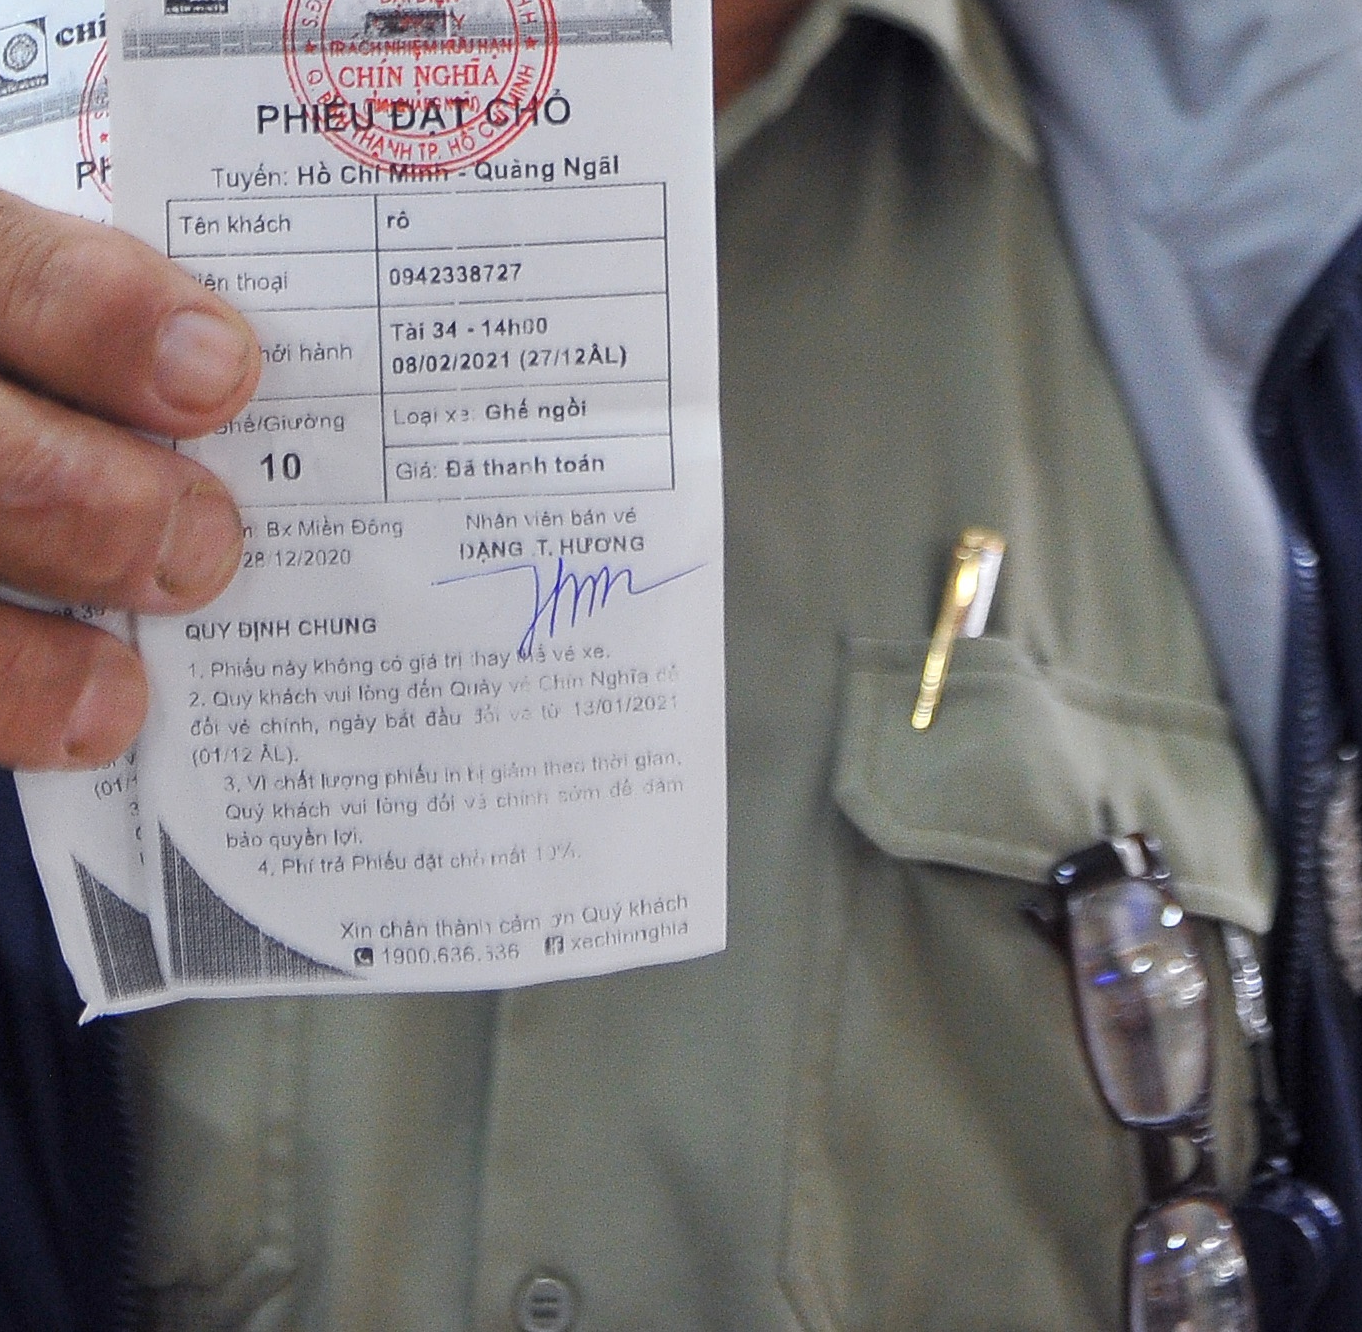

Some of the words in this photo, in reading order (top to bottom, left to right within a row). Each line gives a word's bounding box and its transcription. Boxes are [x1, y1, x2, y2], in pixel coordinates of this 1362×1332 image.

[338, 58, 403, 87] CHÍN
[414, 58, 500, 87] NGHĨA
[256, 93, 374, 134] PHIẾU
[212, 162, 287, 192] Tuyến:
[298, 161, 331, 185] Hồ
[341, 165, 380, 184] Chí
[389, 162, 450, 182] Minh
[475, 159, 554, 181] Quảng
[564, 155, 619, 179] Ngãi
[179, 215, 219, 234] Tên
[228, 214, 291, 233] khách
[387, 210, 410, 229] rô
[192, 272, 229, 291] iện
[237, 271, 288, 293] thoại
[389, 263, 522, 286] 0942338727
[390, 320, 424, 341] Tài
[433, 321, 456, 339] 34
[482, 317, 547, 336] 14h00
[300, 342, 353, 362] hành
[392, 351, 510, 374] 08/02/2021
[520, 343, 627, 371] (27/12ÂL)
[394, 409, 438, 427] Loại
[486, 398, 528, 420] Ghế
[538, 397, 586, 422] ngồi
[260, 453, 301, 481] 10
[395, 461, 438, 480] Giá:
[446, 460, 475, 478] Đã
[484, 457, 546, 476] thanh
[556, 454, 605, 472] toán
[267, 522, 291, 538] Bx
[298, 515, 344, 536] Miền
[351, 519, 403, 539] Đông
[466, 513, 517, 530] Nhân
[524, 511, 563, 527] viên
[571, 510, 606, 526] bán
[613, 507, 637, 523] vé
[560, 536, 645, 555] HƯƠNG
[185, 621, 231, 641] QUY
[238, 620, 290, 642] ĐỊNH
[298, 618, 377, 635] CHUNG
[189, 663, 203, 678] 1.
[211, 657, 265, 678] Phiếu
[272, 661, 307, 679] này
[313, 658, 372, 675] không
[380, 656, 403, 672] có
[409, 654, 437, 674] giá
[445, 651, 462, 671] trị
[471, 651, 510, 669] thay
[553, 646, 575, 661] vé
[582, 645, 610, 659] xe.
[189, 692, 205, 707] 2.
[259, 688, 317, 705] khách
[324, 686, 351, 702] vui
[359, 685, 399, 704] lòng
[407, 678, 442, 699] đến
[450, 679, 502, 698] Quầy
[591, 669, 648, 690] Nghĩa
[190, 716, 218, 736] đổi
[228, 717, 250, 734] vé
[260, 717, 319, 735] chính,
[329, 713, 376, 733] ngày
[385, 708, 415, 729] bắt
[425, 706, 461, 727] đầu
[192, 746, 253, 768] (01/12
[260, 744, 298, 765] ÂL).
[247, 774, 266, 791] Vì
[274, 769, 314, 791] chất
[321, 773, 378, 791] lượng
[385, 764, 437, 789] phiếu
[445, 768, 461, 783] in
[491, 762, 536, 783] giảm
[592, 753, 628, 771] thời
[225, 804, 264, 822] Quý
[272, 801, 330, 818] khách
[340, 799, 367, 815] vui
[376, 797, 418, 817] lòng
[427, 794, 455, 813] đổi
[496, 791, 548, 808] chính
[226, 831, 262, 849] bảo
[269, 826, 327, 850] quyền
[334, 828, 362, 847] lợi.
[258, 861, 274, 876] 4.
[282, 858, 314, 874] Phí
[320, 856, 345, 873] trả
[352, 850, 406, 871] Phiếu
[414, 853, 442, 873] đặt
[491, 843, 525, 866] mất
[341, 922, 372, 940] Xin
[380, 919, 428, 939] chân
[436, 917, 491, 938] thành
[499, 914, 541, 934] cảm
[582, 902, 622, 924] Quý
[629, 894, 689, 917] khách
